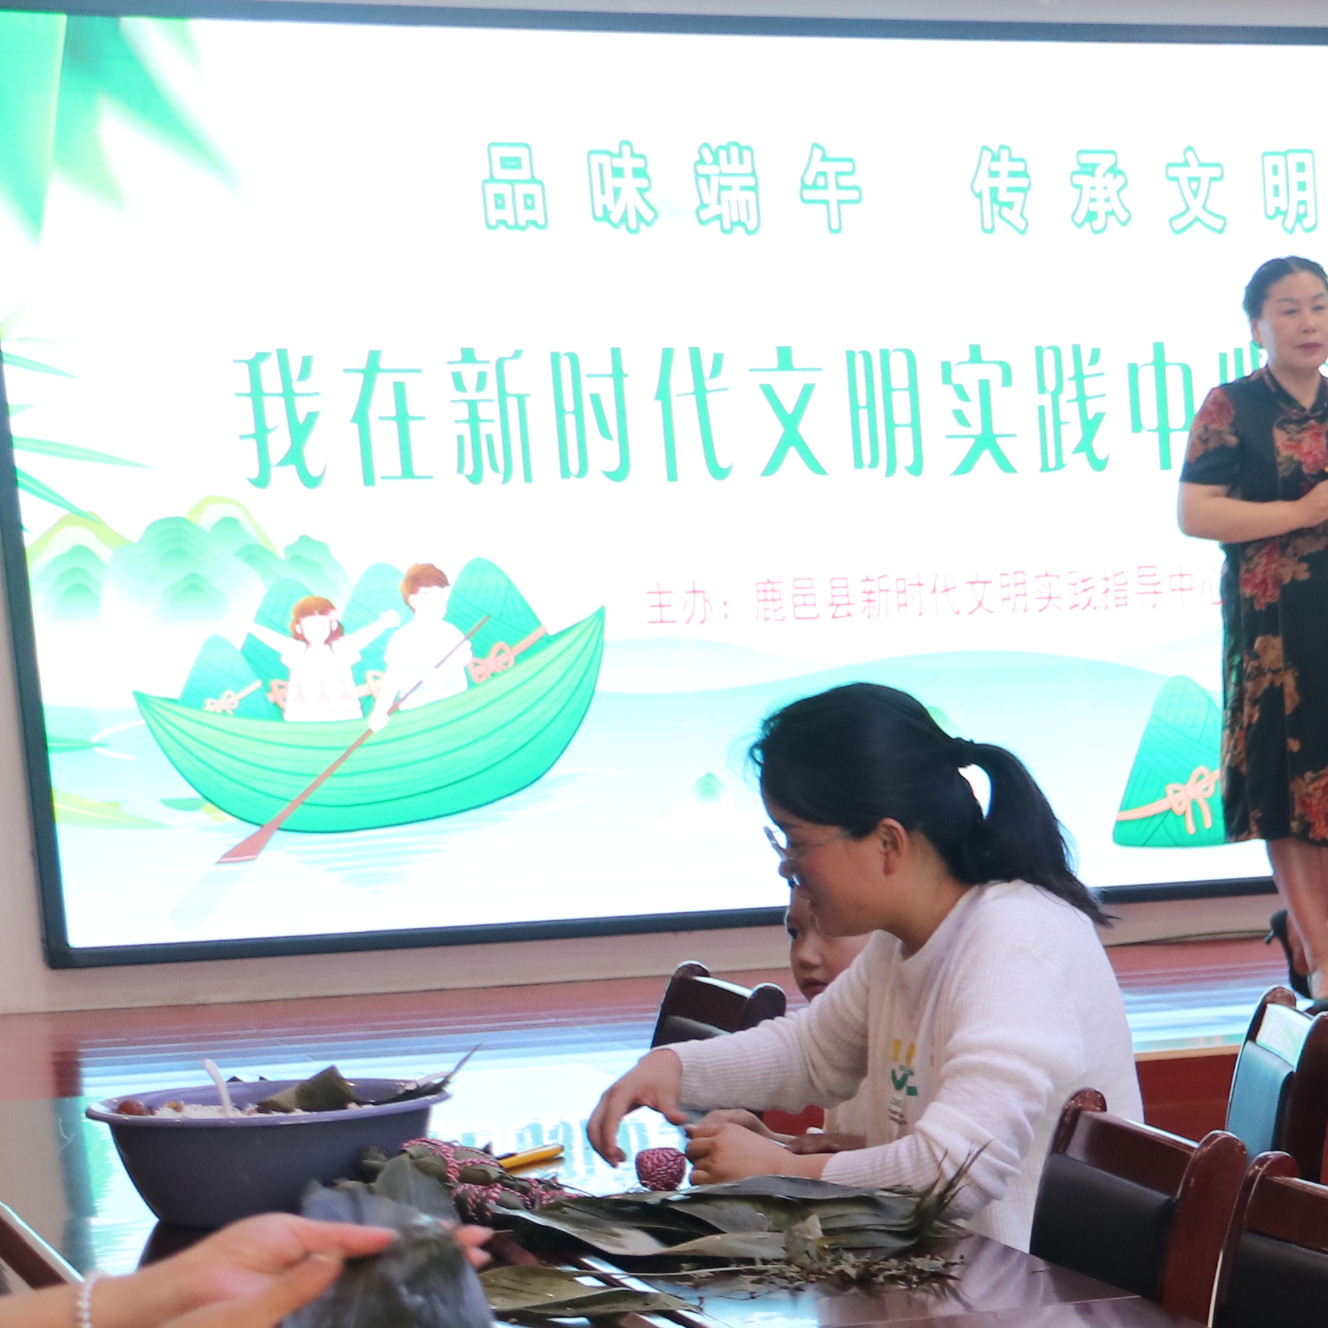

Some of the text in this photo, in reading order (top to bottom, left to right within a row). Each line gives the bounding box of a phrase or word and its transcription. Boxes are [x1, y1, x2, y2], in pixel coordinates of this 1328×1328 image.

[482, 139, 1319, 235] 品味端午 传承文明
